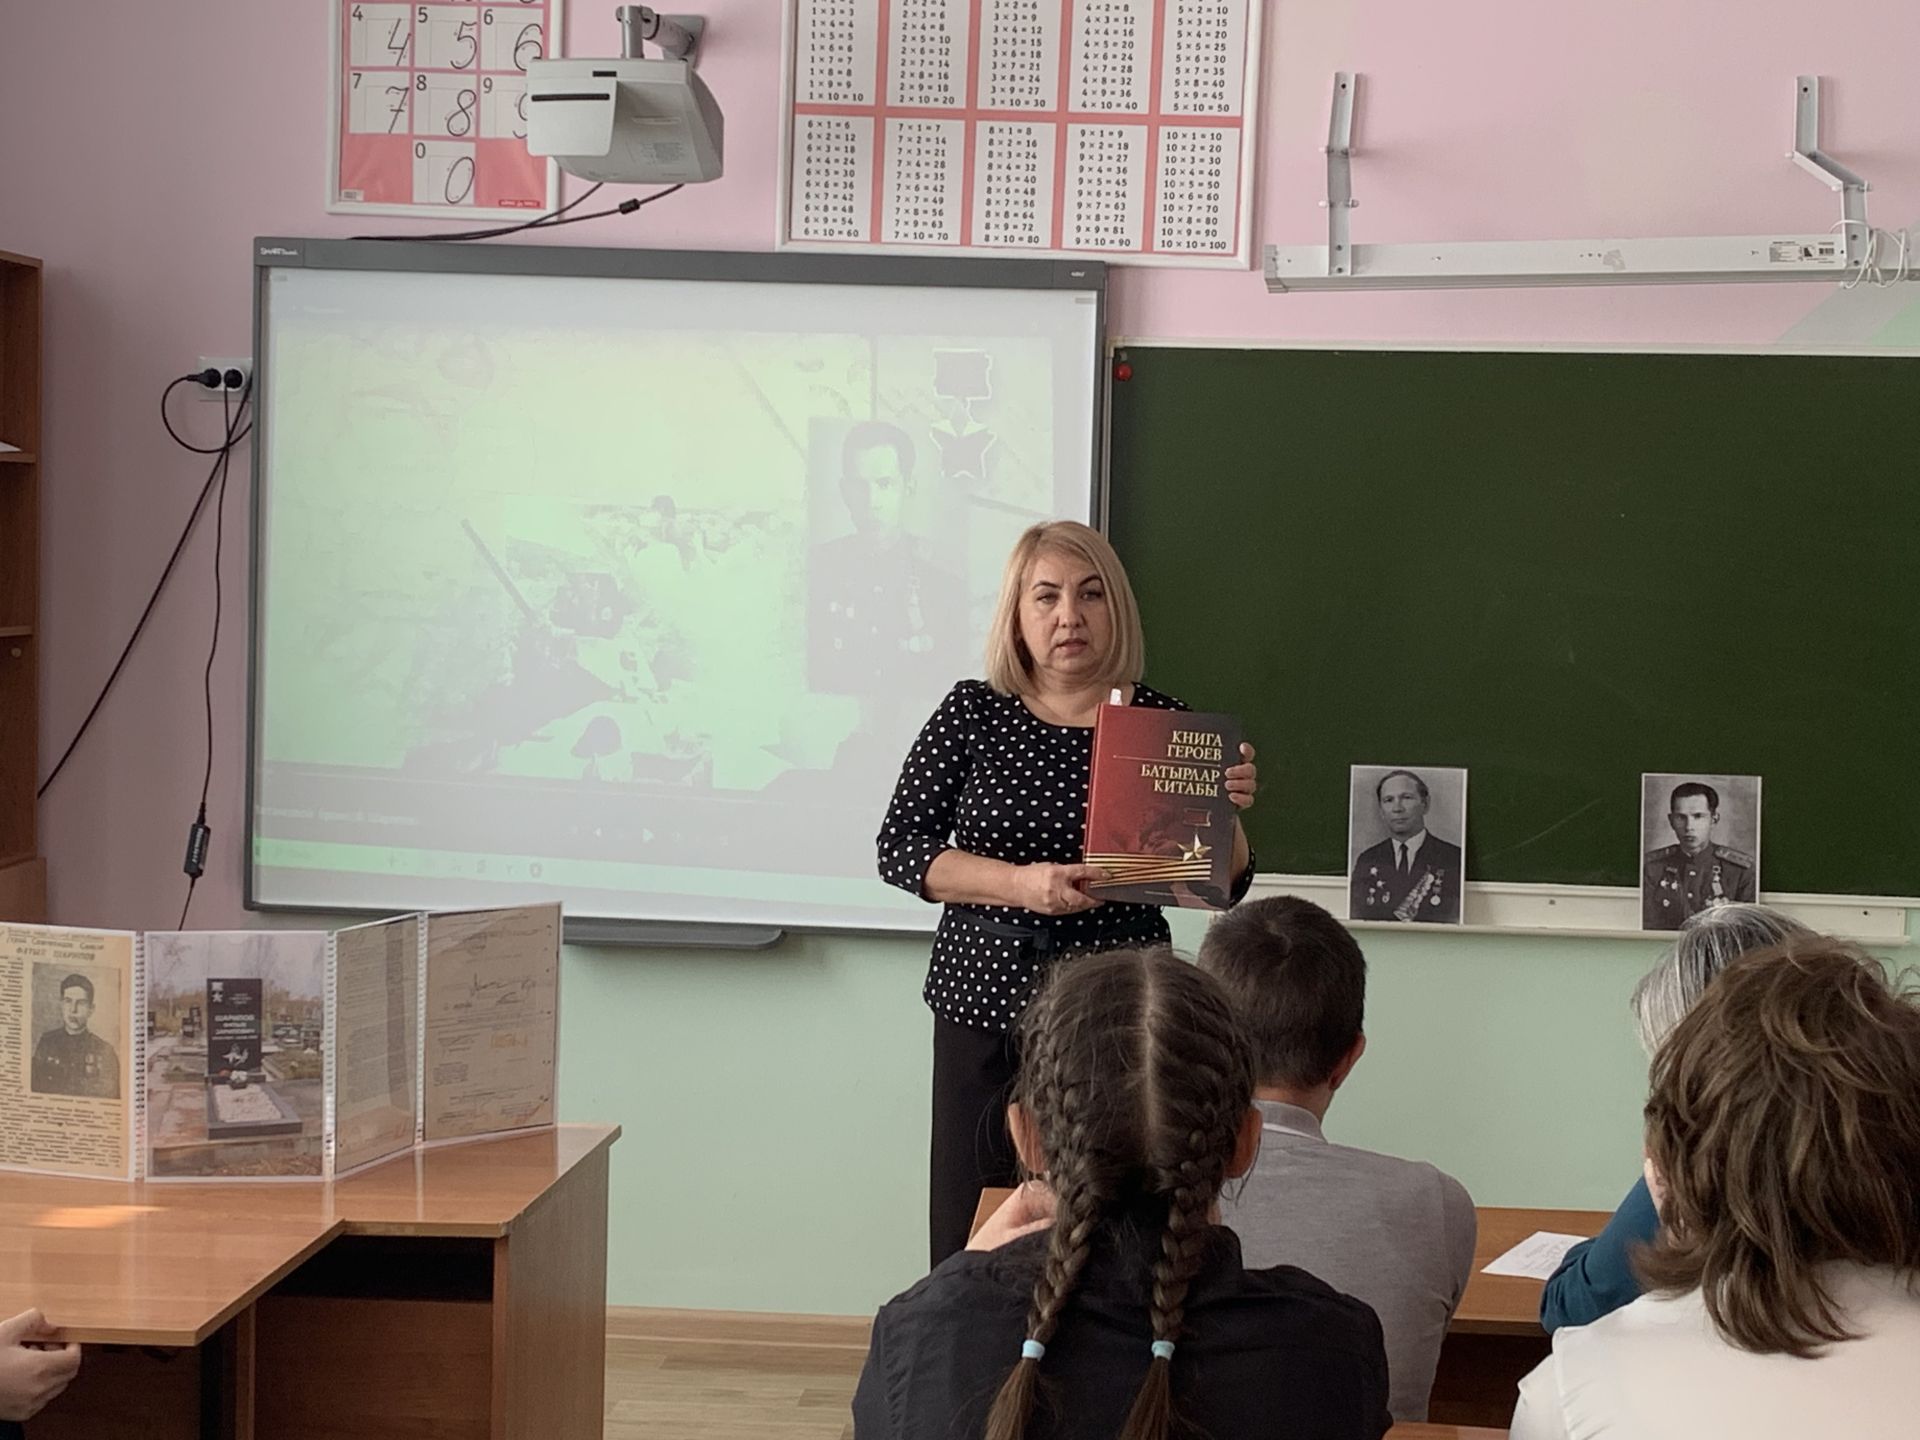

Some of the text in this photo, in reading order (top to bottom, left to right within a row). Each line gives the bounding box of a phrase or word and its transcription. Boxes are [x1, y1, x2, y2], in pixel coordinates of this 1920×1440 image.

[352, 5, 363, 21] 4
[418, 7, 428, 23] 5
[1216, 6, 1229, 15] 10
[484, 9, 493, 25] 6
[1122, 28, 1134, 37] 16
[387, 18, 411, 66] 4
[939, 35, 951, 44] 10
[1030, 38, 1042, 47] 15
[450, 21, 477, 69] 5
[514, 23, 543, 71] 6
[1214, 42, 1226, 52] 25
[938, 47, 950, 56] 12
[1120, 52, 1134, 61] 24
[352, 73, 362, 89] 7
[416, 74, 427, 91] 8
[483, 77, 493, 93] 9
[828, 92, 840, 101] 10
[852, 93, 864, 102] 10
[918, 95, 930, 104] 10
[942, 96, 955, 105] 20
[1010, 98, 1022, 107] 10
[1033, 98, 1046, 108] 30
[1101, 101, 1113, 110] 10
[1124, 101, 1138, 110] 40
[1193, 103, 1205, 112] 10
[1217, 103, 1230, 112] 50
[385, 86, 410, 134] 7
[446, 89, 477, 137] 8
[415, 142, 426, 158] 0
[1166, 143, 1178, 152] 10
[1208, 144, 1222, 153] 20
[842, 169, 855, 178] 30
[1116, 166, 1128, 175] 36
[1164, 167, 1177, 176] 10
[1207, 168, 1221, 177] 40
[445, 156, 475, 204] 0
[1023, 175, 1037, 184] 40
[932, 184, 945, 193] 42
[823, 228, 835, 237] 10
[846, 229, 859, 238] 60
[913, 231, 925, 240] 10
[937, 232, 949, 241] 70
[1003, 234, 1015, 243] 10
[1027, 235, 1040, 244] 80
[1094, 237, 1106, 246] 10
[1118, 238, 1131, 247] 90
[1161, 239, 1173, 248] 10
[1186, 240, 1198, 249] 10
[1209, 241, 1227, 250] 100
[1172, 730, 1222, 747] КНИГА
[1167, 744, 1222, 760] ГЕРОЕВ
[1141, 764, 1220, 782] БАТЫРЛАР
[1154, 780, 1218, 797] КИТАБЫ
